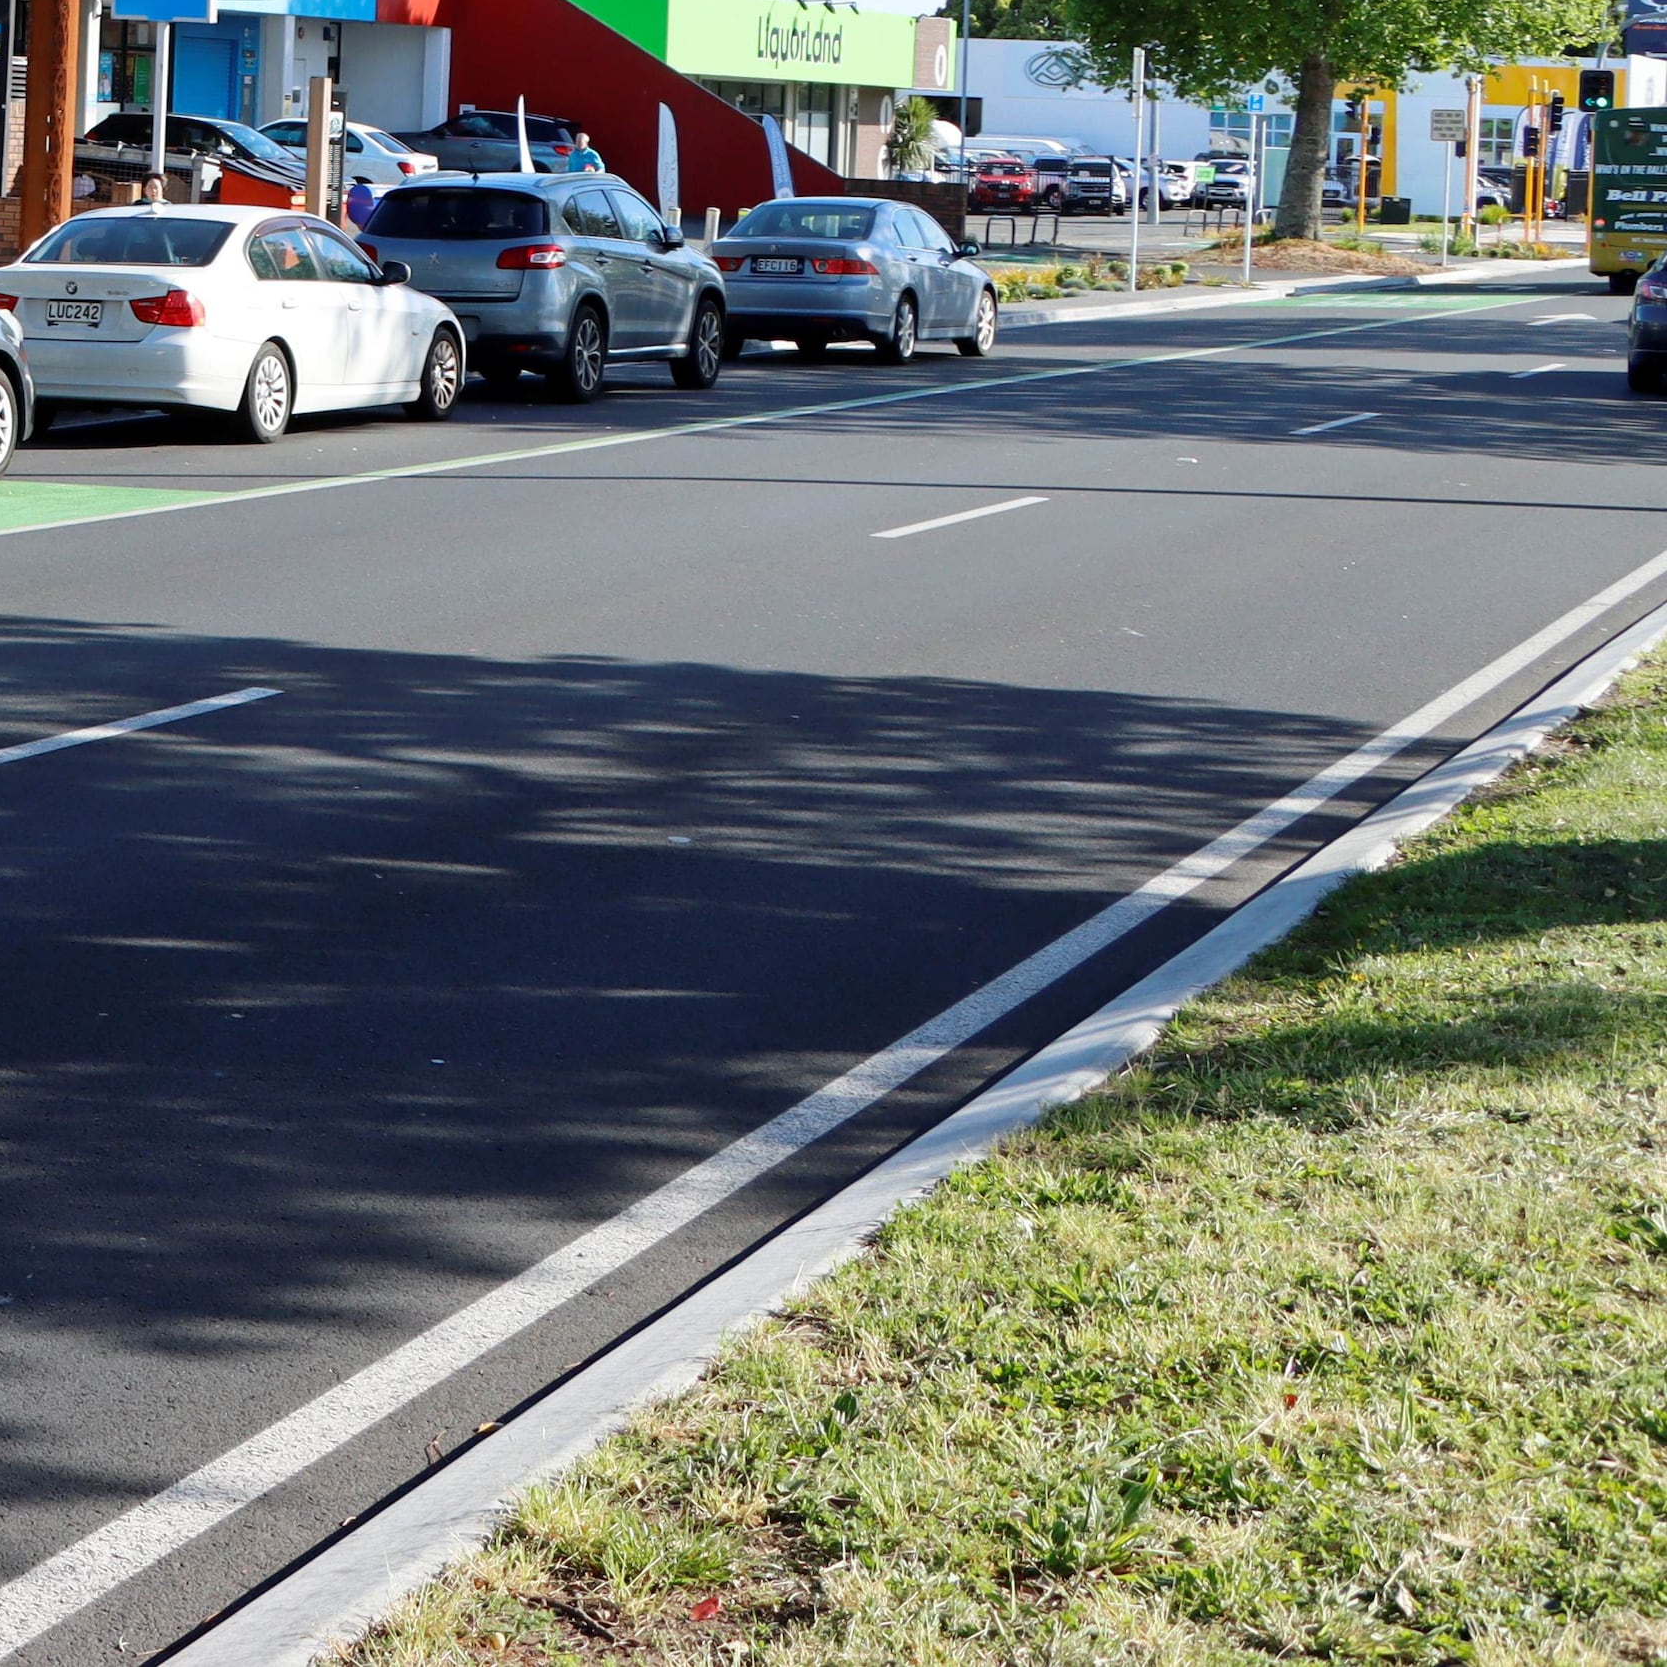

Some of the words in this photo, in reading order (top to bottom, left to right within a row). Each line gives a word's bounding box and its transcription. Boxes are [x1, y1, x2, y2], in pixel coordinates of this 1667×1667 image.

[1606, 189, 1648, 201] Bell
[1614, 220, 1665, 232] Plumbers
[758, 260, 796, 271] EFC116
[48, 304, 100, 320] LUC242
